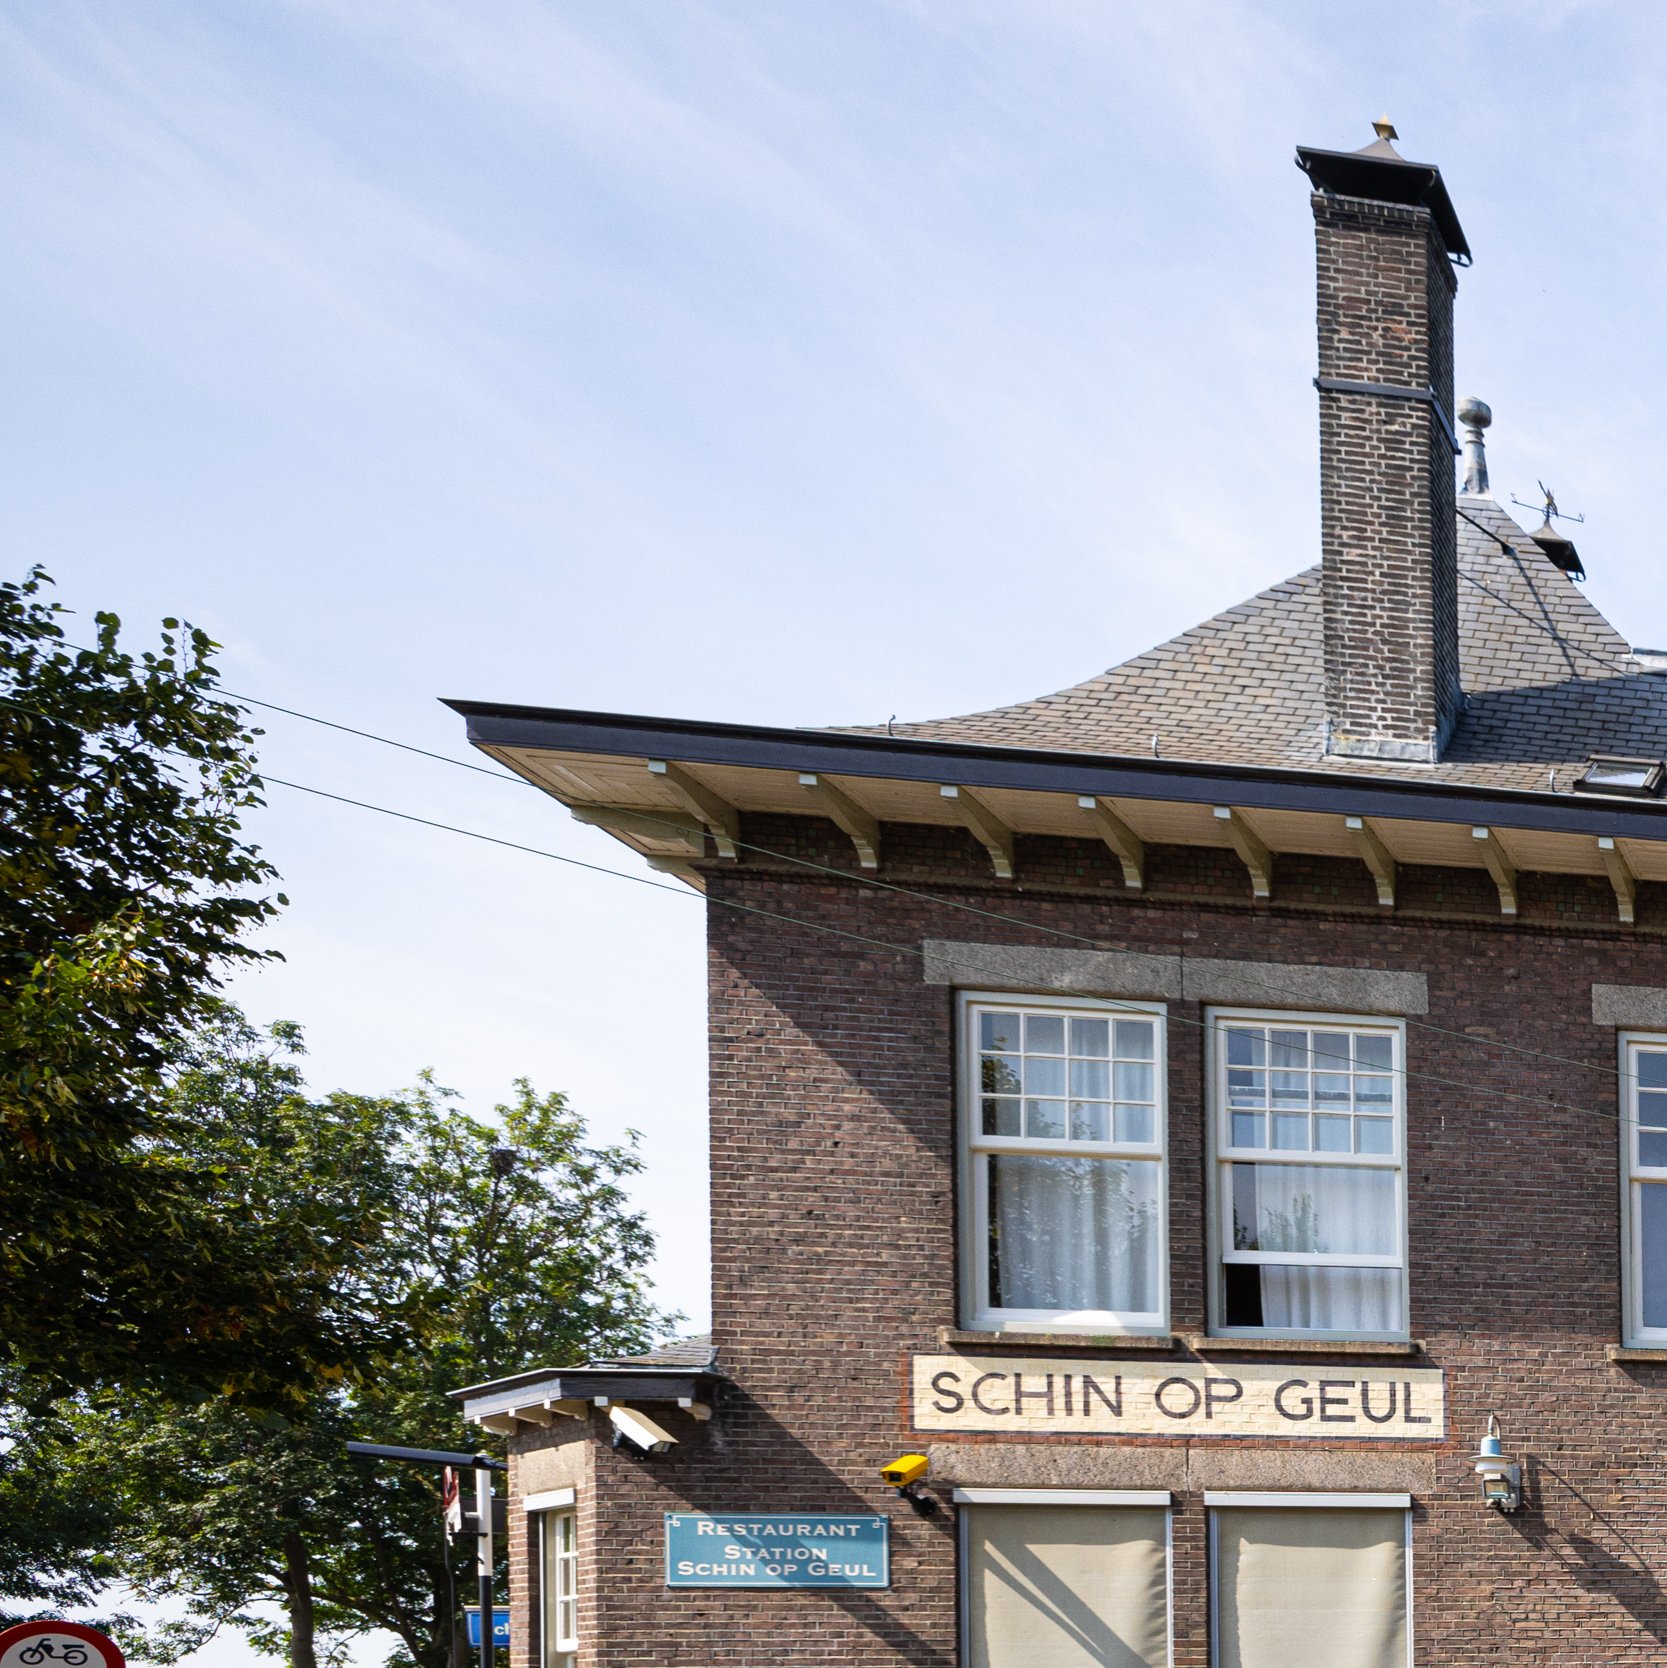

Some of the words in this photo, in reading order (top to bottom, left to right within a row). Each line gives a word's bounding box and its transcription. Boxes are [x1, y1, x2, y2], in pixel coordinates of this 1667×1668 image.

[931, 1371, 1123, 1418] SCHIN
[1154, 1376, 1243, 1420] OP
[1274, 1379, 1432, 1424] GEUL
[697, 1521, 860, 1537] RESTAURANT
[724, 1545, 828, 1560] STATION
[677, 1561, 756, 1576] SCHIN
[807, 1562, 877, 1577] GEUL
